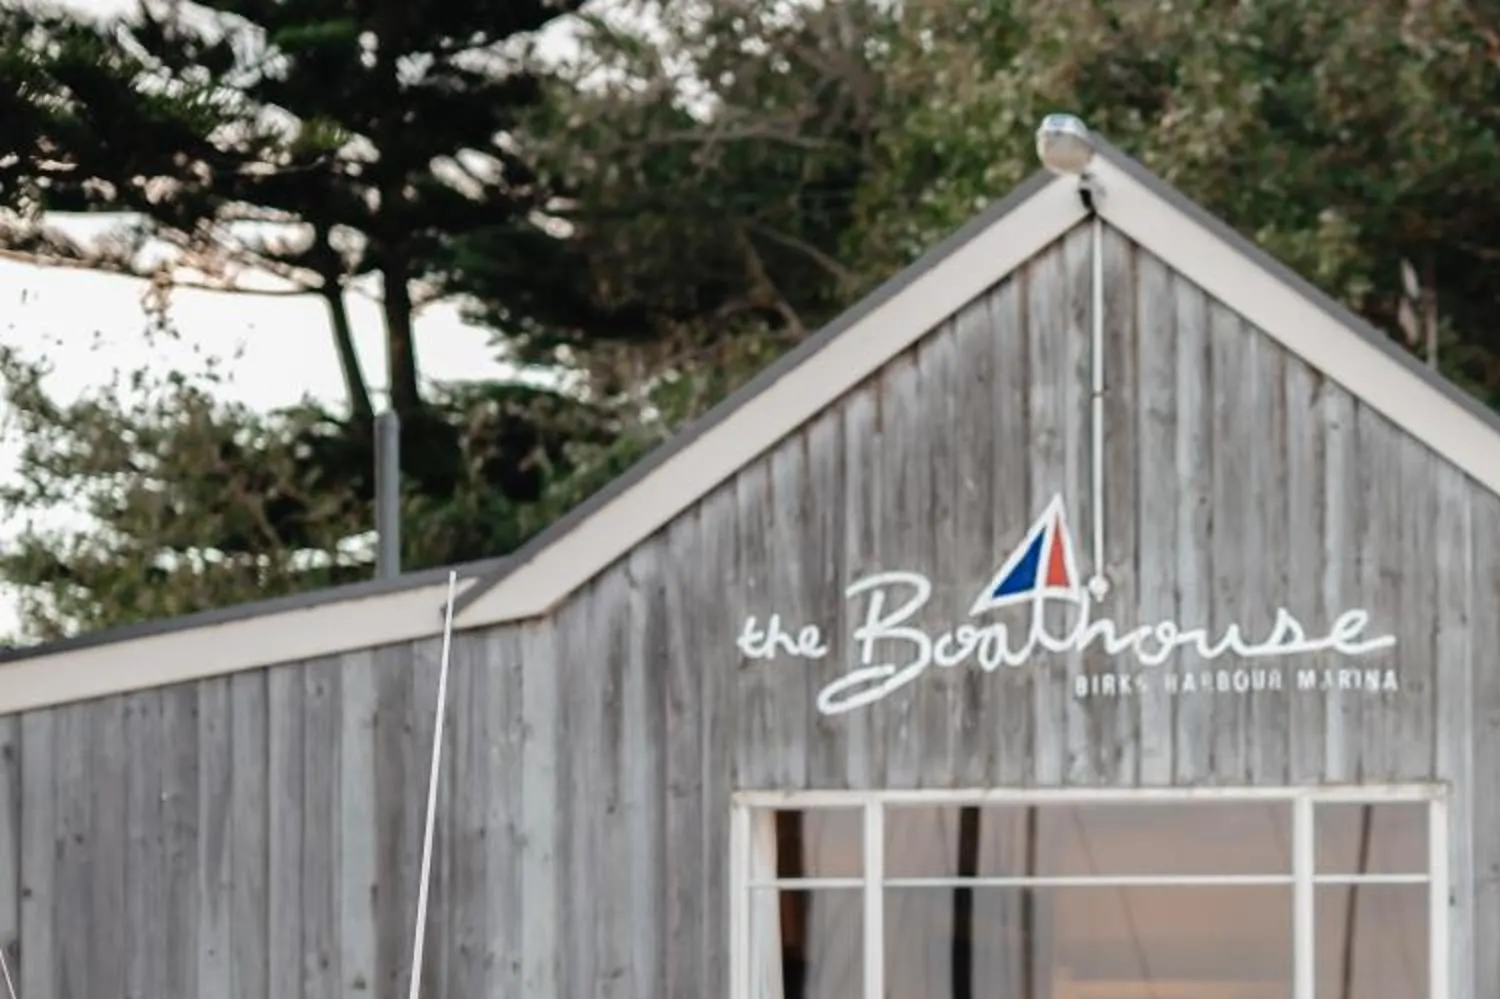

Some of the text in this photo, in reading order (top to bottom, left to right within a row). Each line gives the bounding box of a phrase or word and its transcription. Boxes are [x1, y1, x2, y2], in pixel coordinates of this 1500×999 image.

[737, 493, 1397, 715] the Boathouse
[1297, 668, 1399, 692] MARINA
